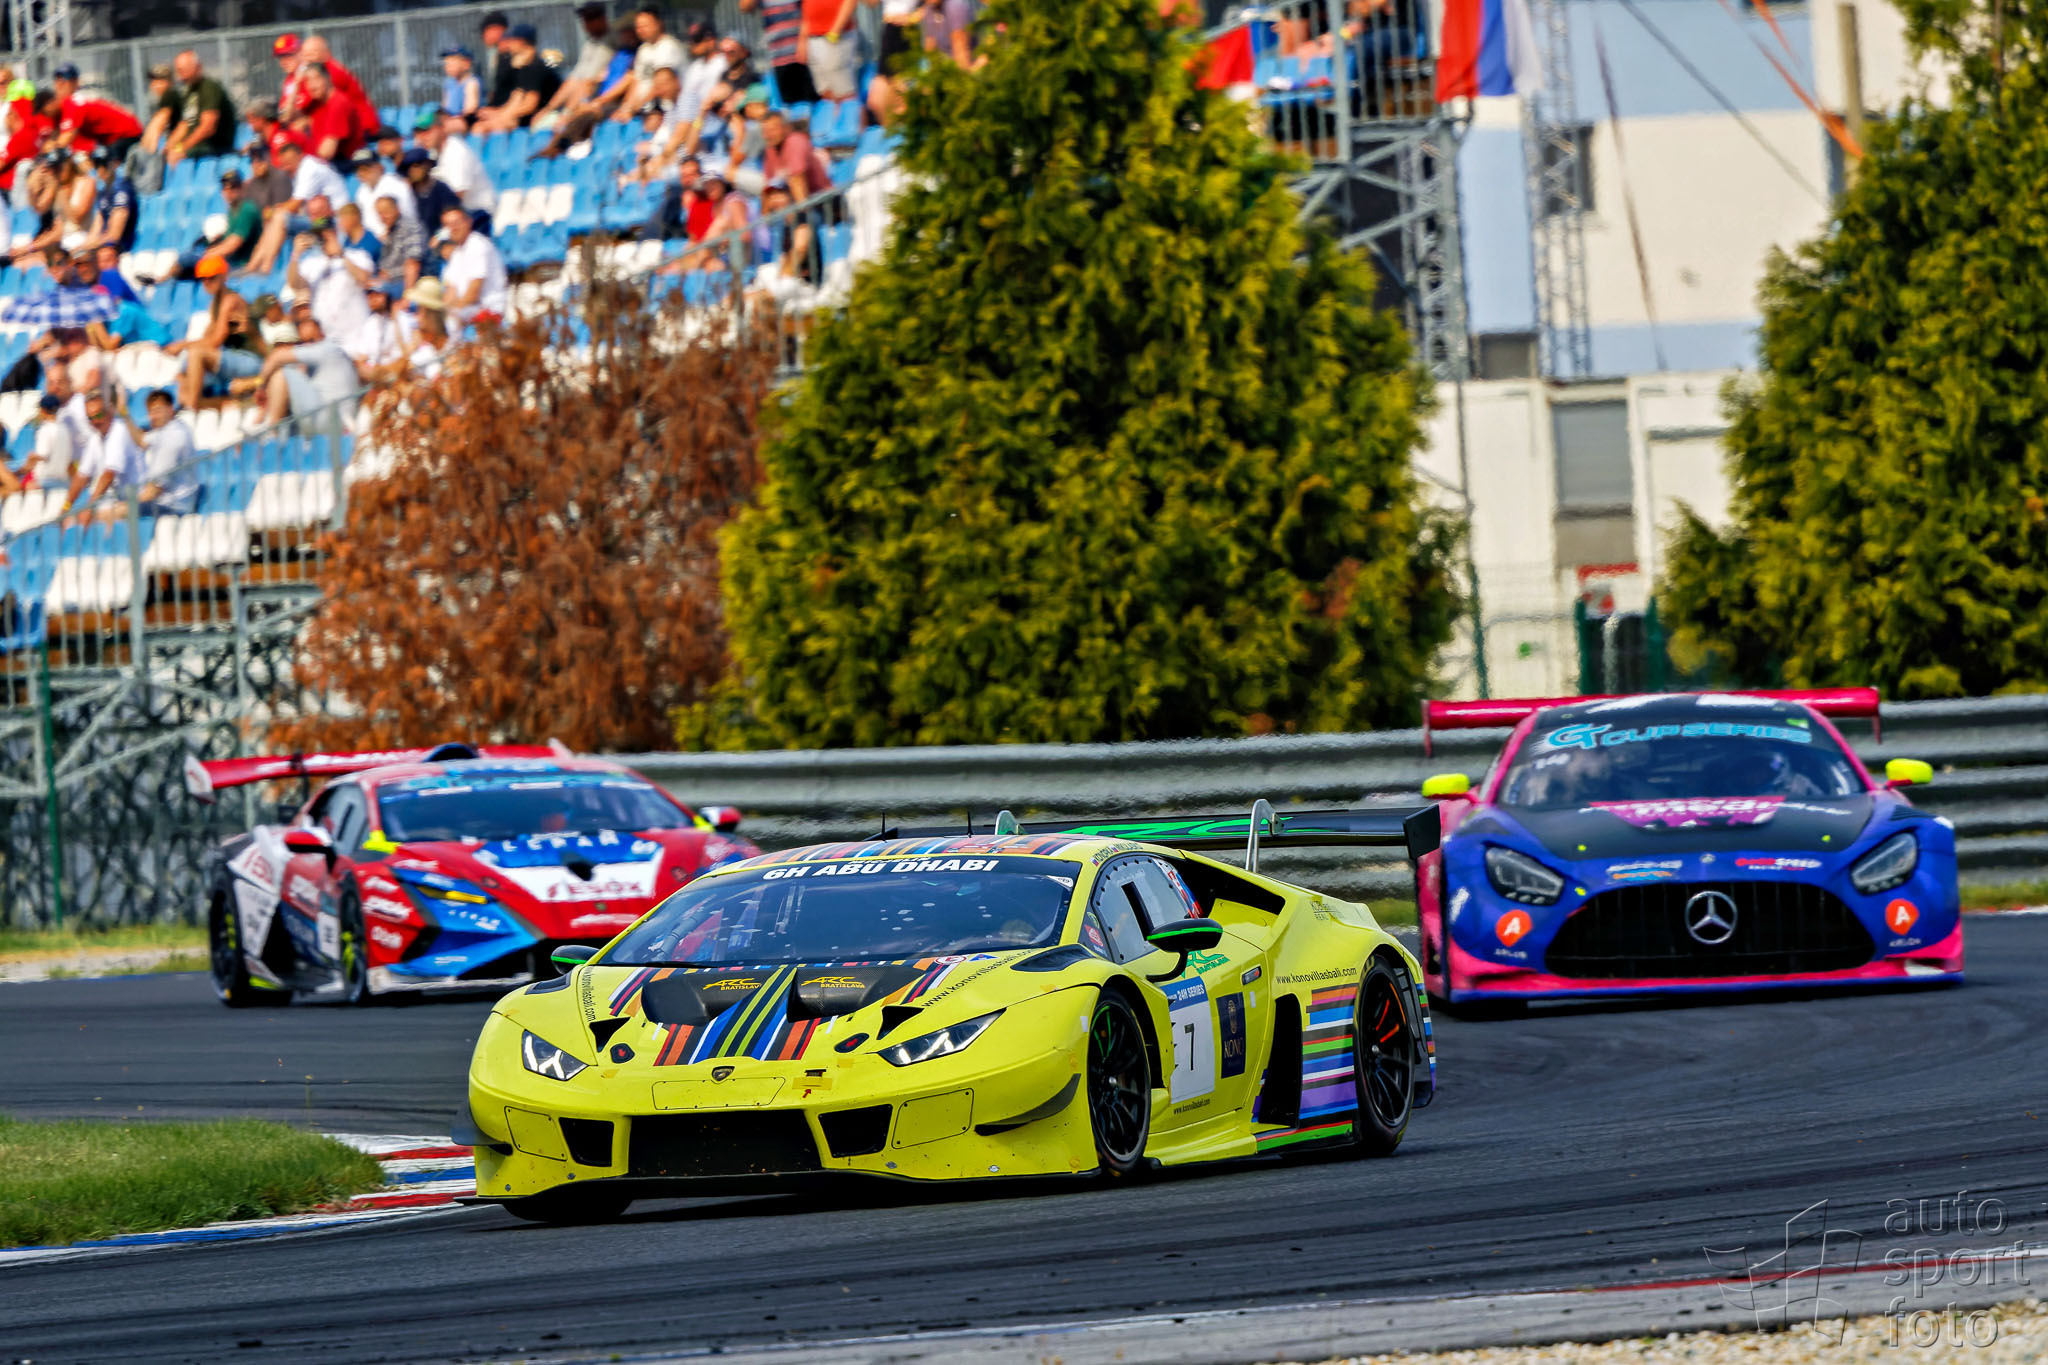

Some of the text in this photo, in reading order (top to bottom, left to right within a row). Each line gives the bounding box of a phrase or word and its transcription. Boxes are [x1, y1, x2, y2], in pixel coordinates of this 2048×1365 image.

[762, 867, 812, 881] 6H
[811, 862, 886, 877] ABU
[890, 859, 1000, 873] DHABI
[1895, 906, 1911, 924] A
[1504, 918, 1521, 937] A
[801, 976, 864, 986] ARC
[1276, 967, 1358, 984] www.konovillasbali.com
[720, 983, 762, 991] BRATISLAV
[1188, 984, 1205, 999] SERIES
